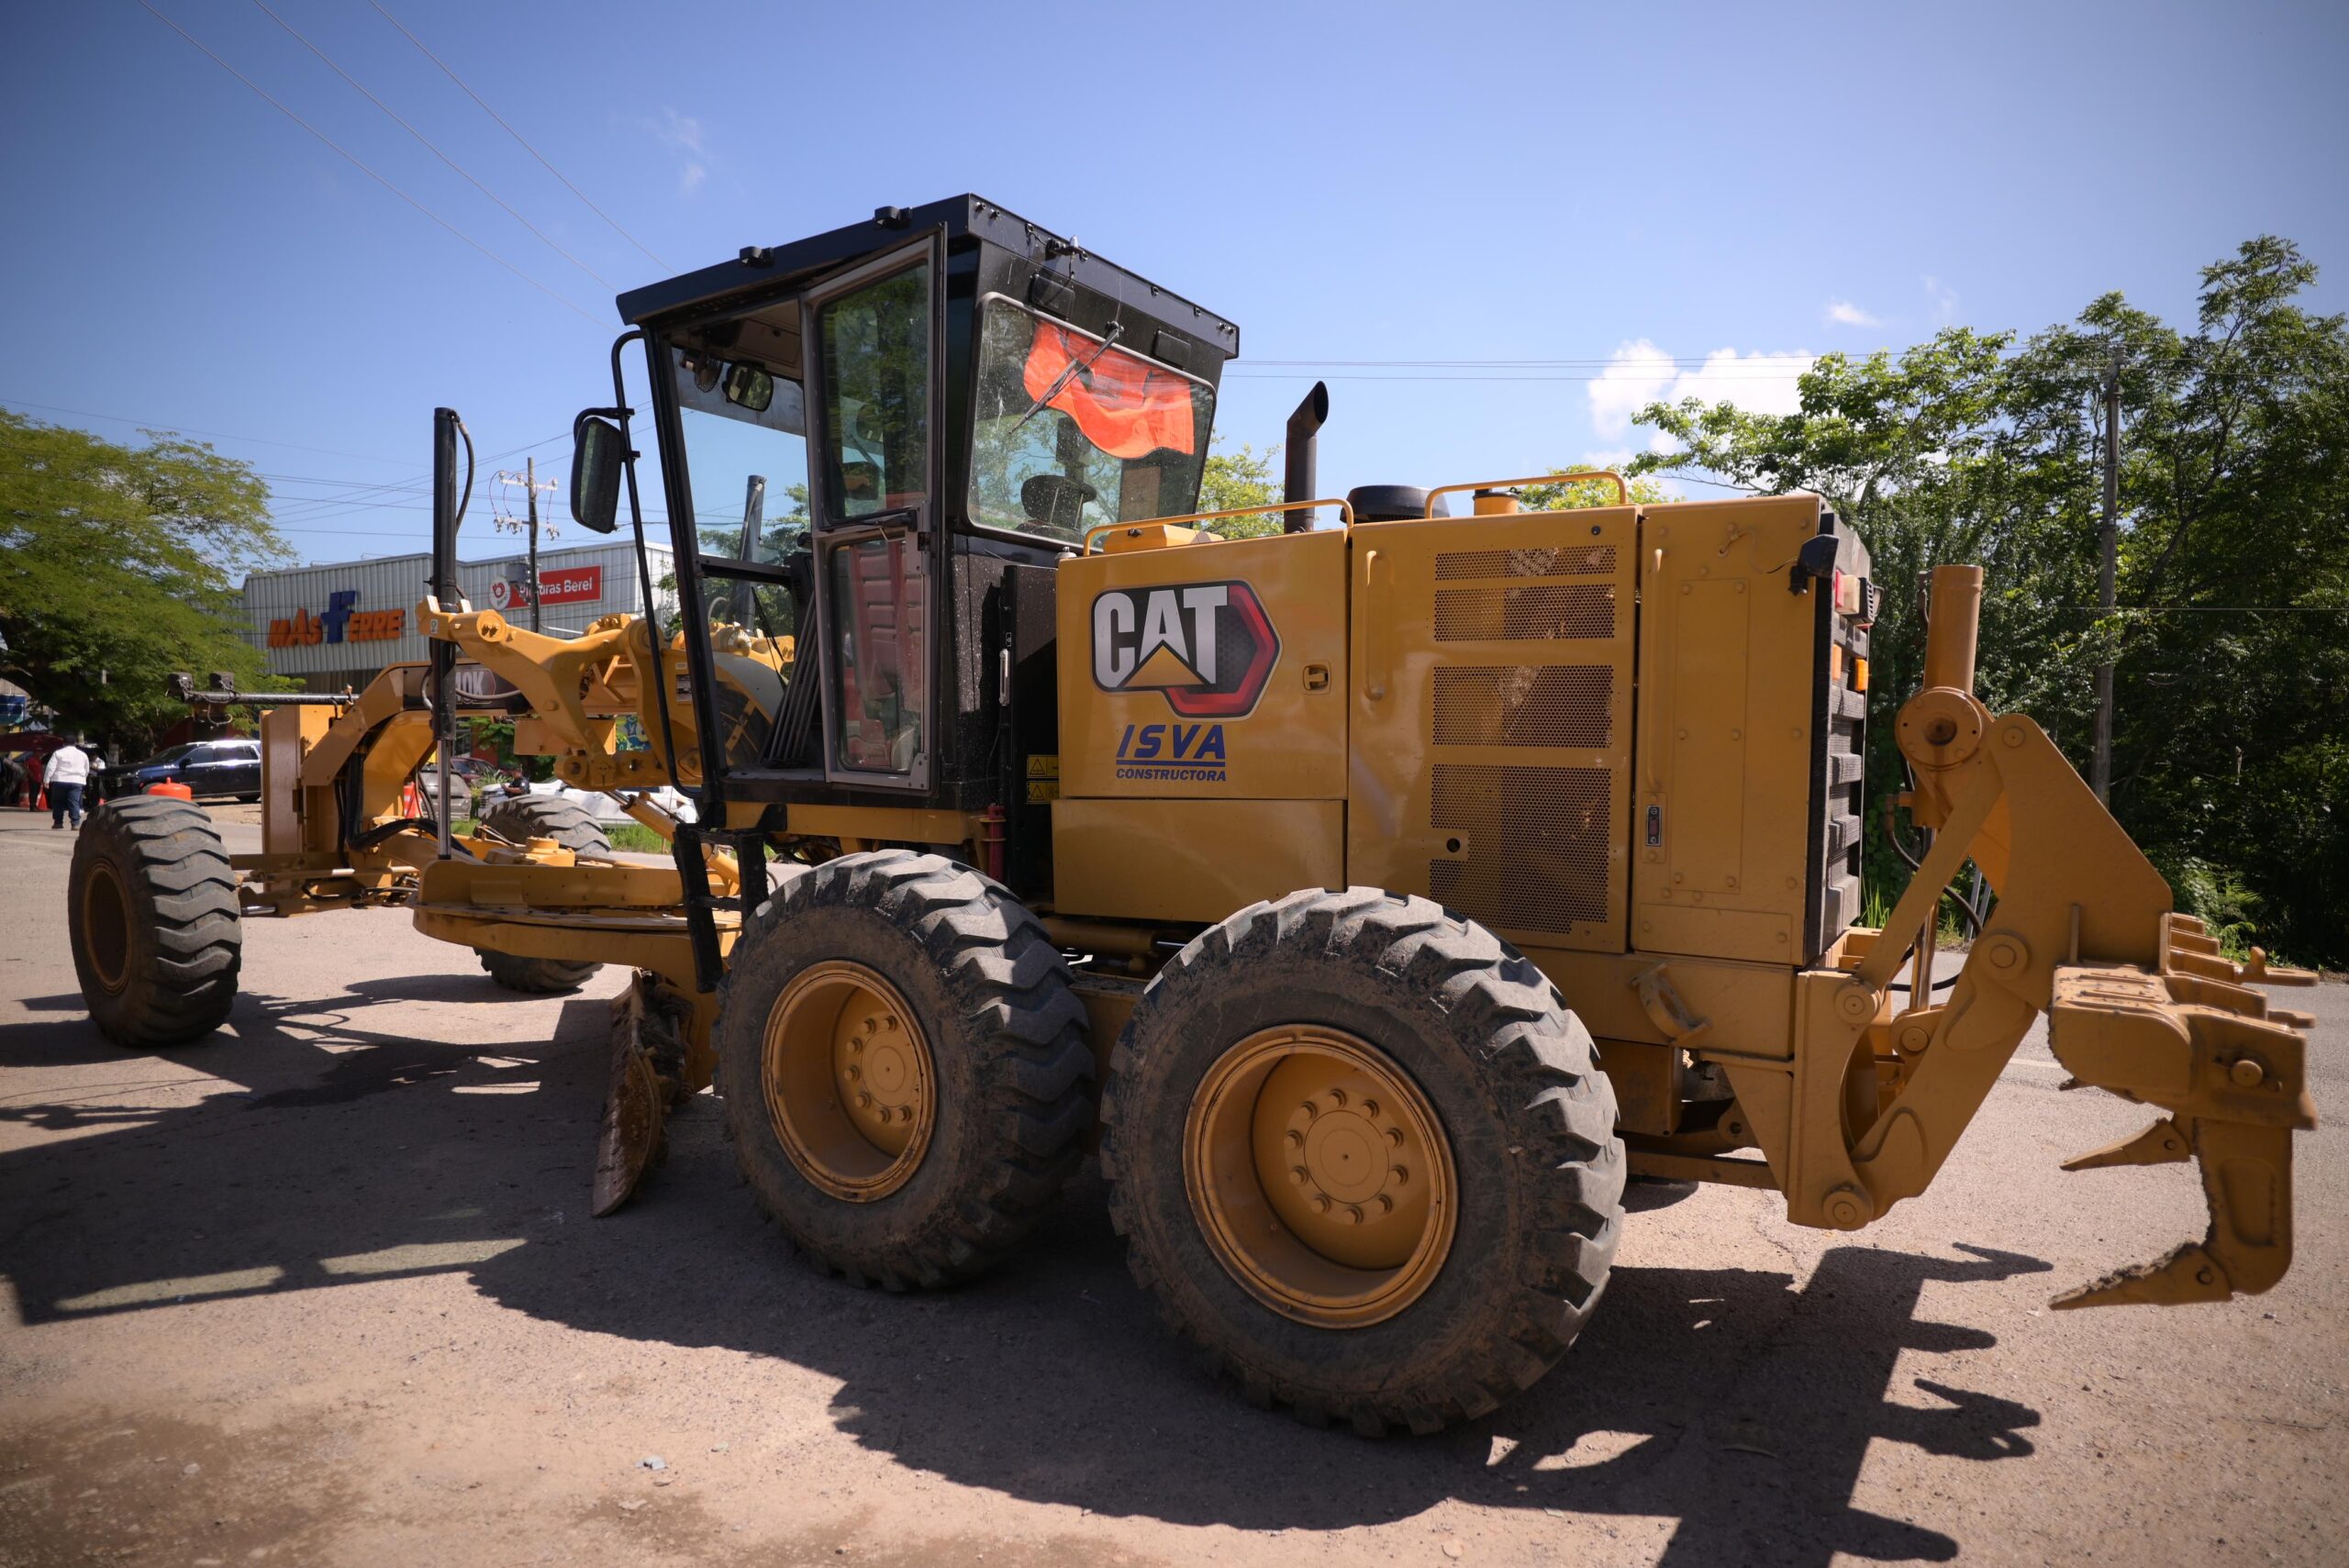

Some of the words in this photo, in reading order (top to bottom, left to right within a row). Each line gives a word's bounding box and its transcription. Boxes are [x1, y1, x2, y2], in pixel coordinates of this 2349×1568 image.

[563, 577, 593, 593] Berel
[1094, 585, 1228, 688] CAT
[1116, 724, 1227, 760] ISVA
[1116, 768, 1227, 782] CONSTRUCTORA
